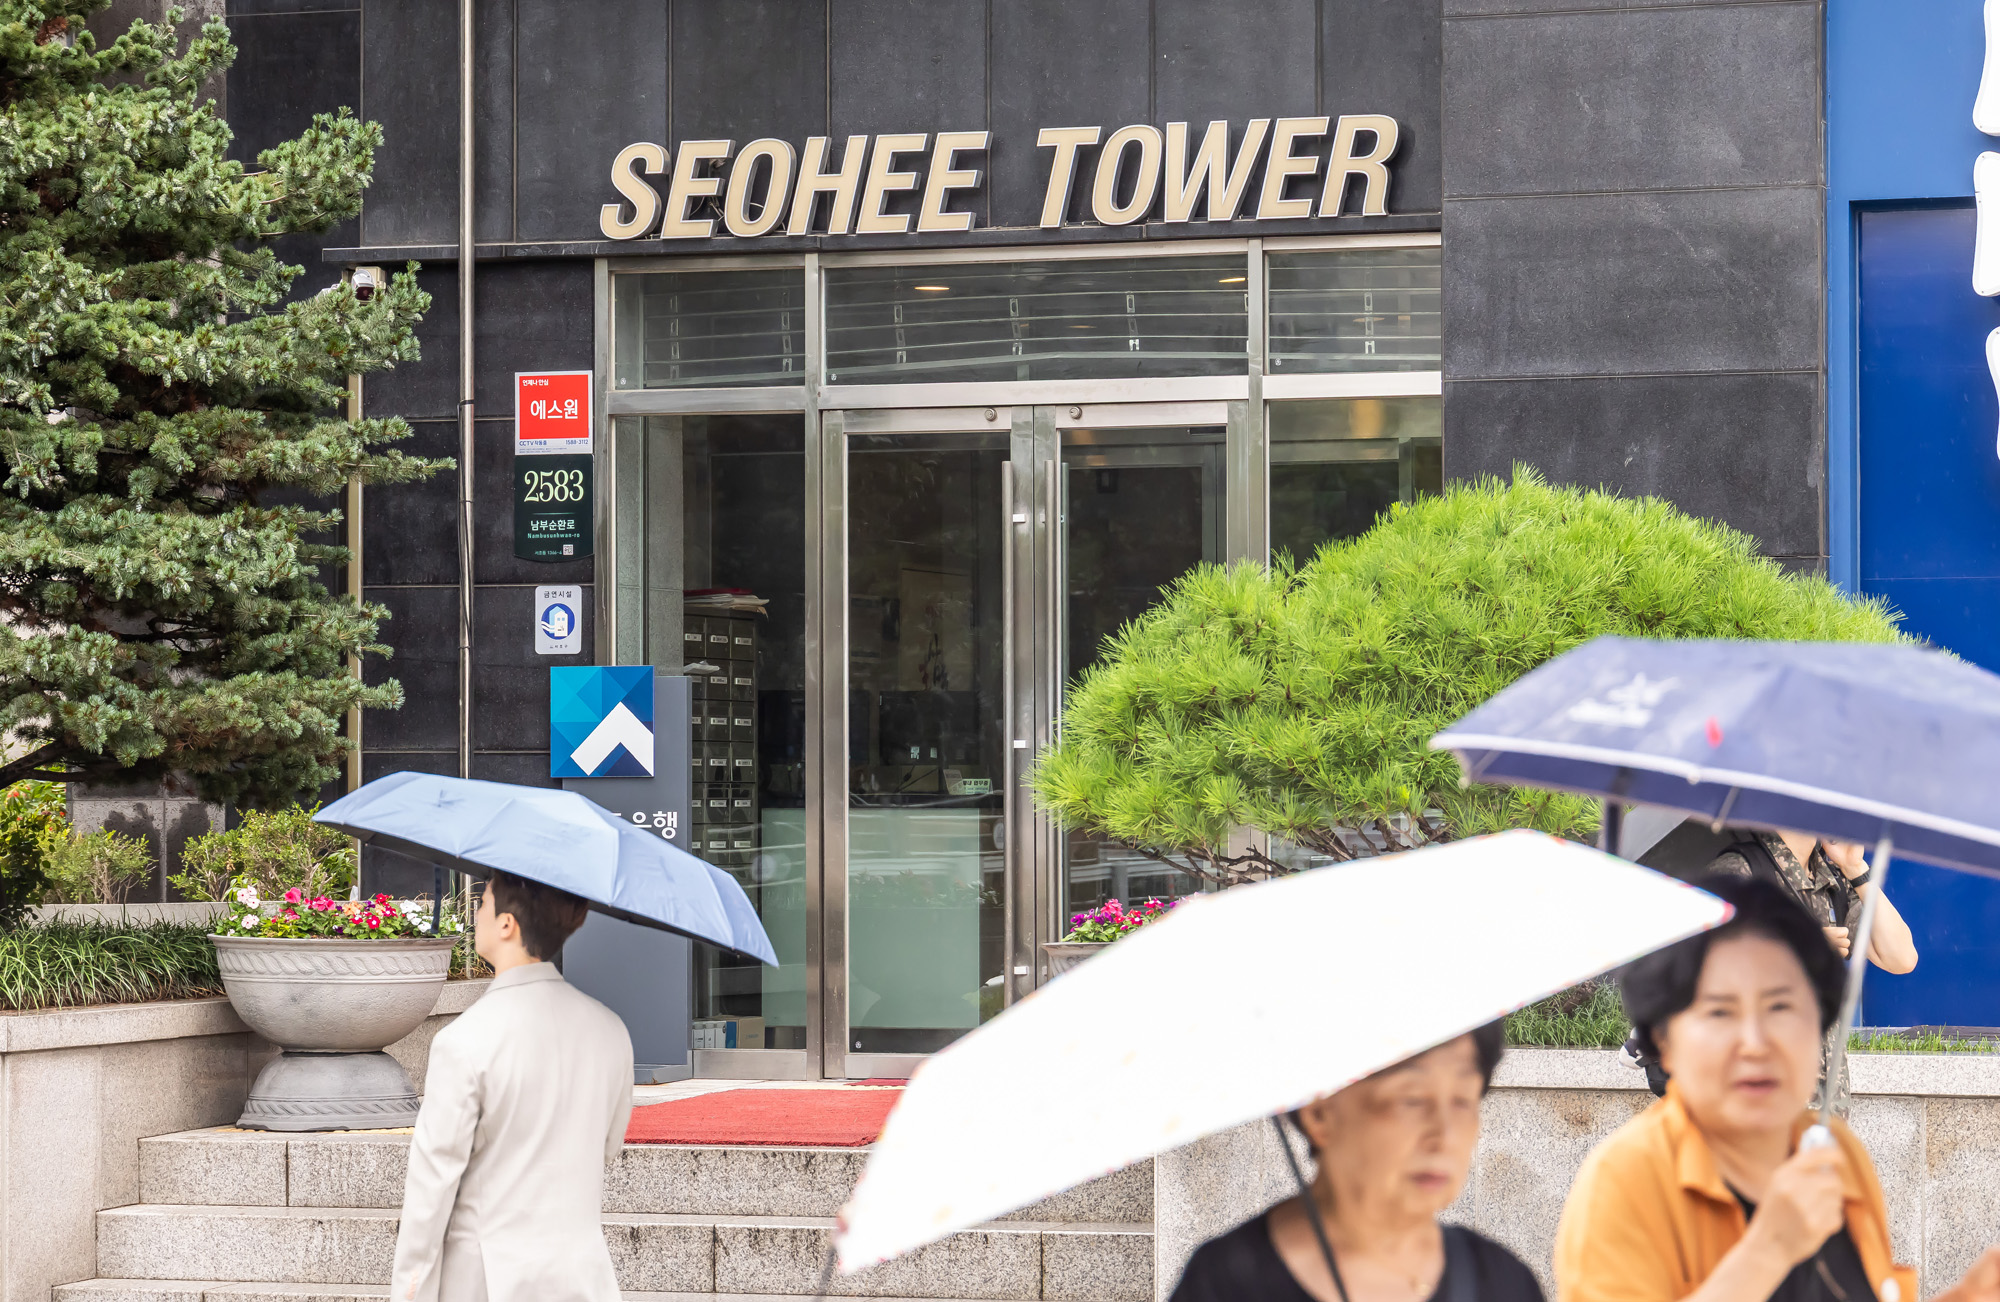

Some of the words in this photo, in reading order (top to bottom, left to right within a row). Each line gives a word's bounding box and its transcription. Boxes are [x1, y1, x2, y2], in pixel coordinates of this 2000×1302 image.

[600, 131, 993, 240] SEOHEE
[1037, 114, 1399, 228] TOWER
[531, 399, 578, 419] 에스원
[524, 469, 584, 502] 2583
[531, 520, 575, 531] 남부순환로
